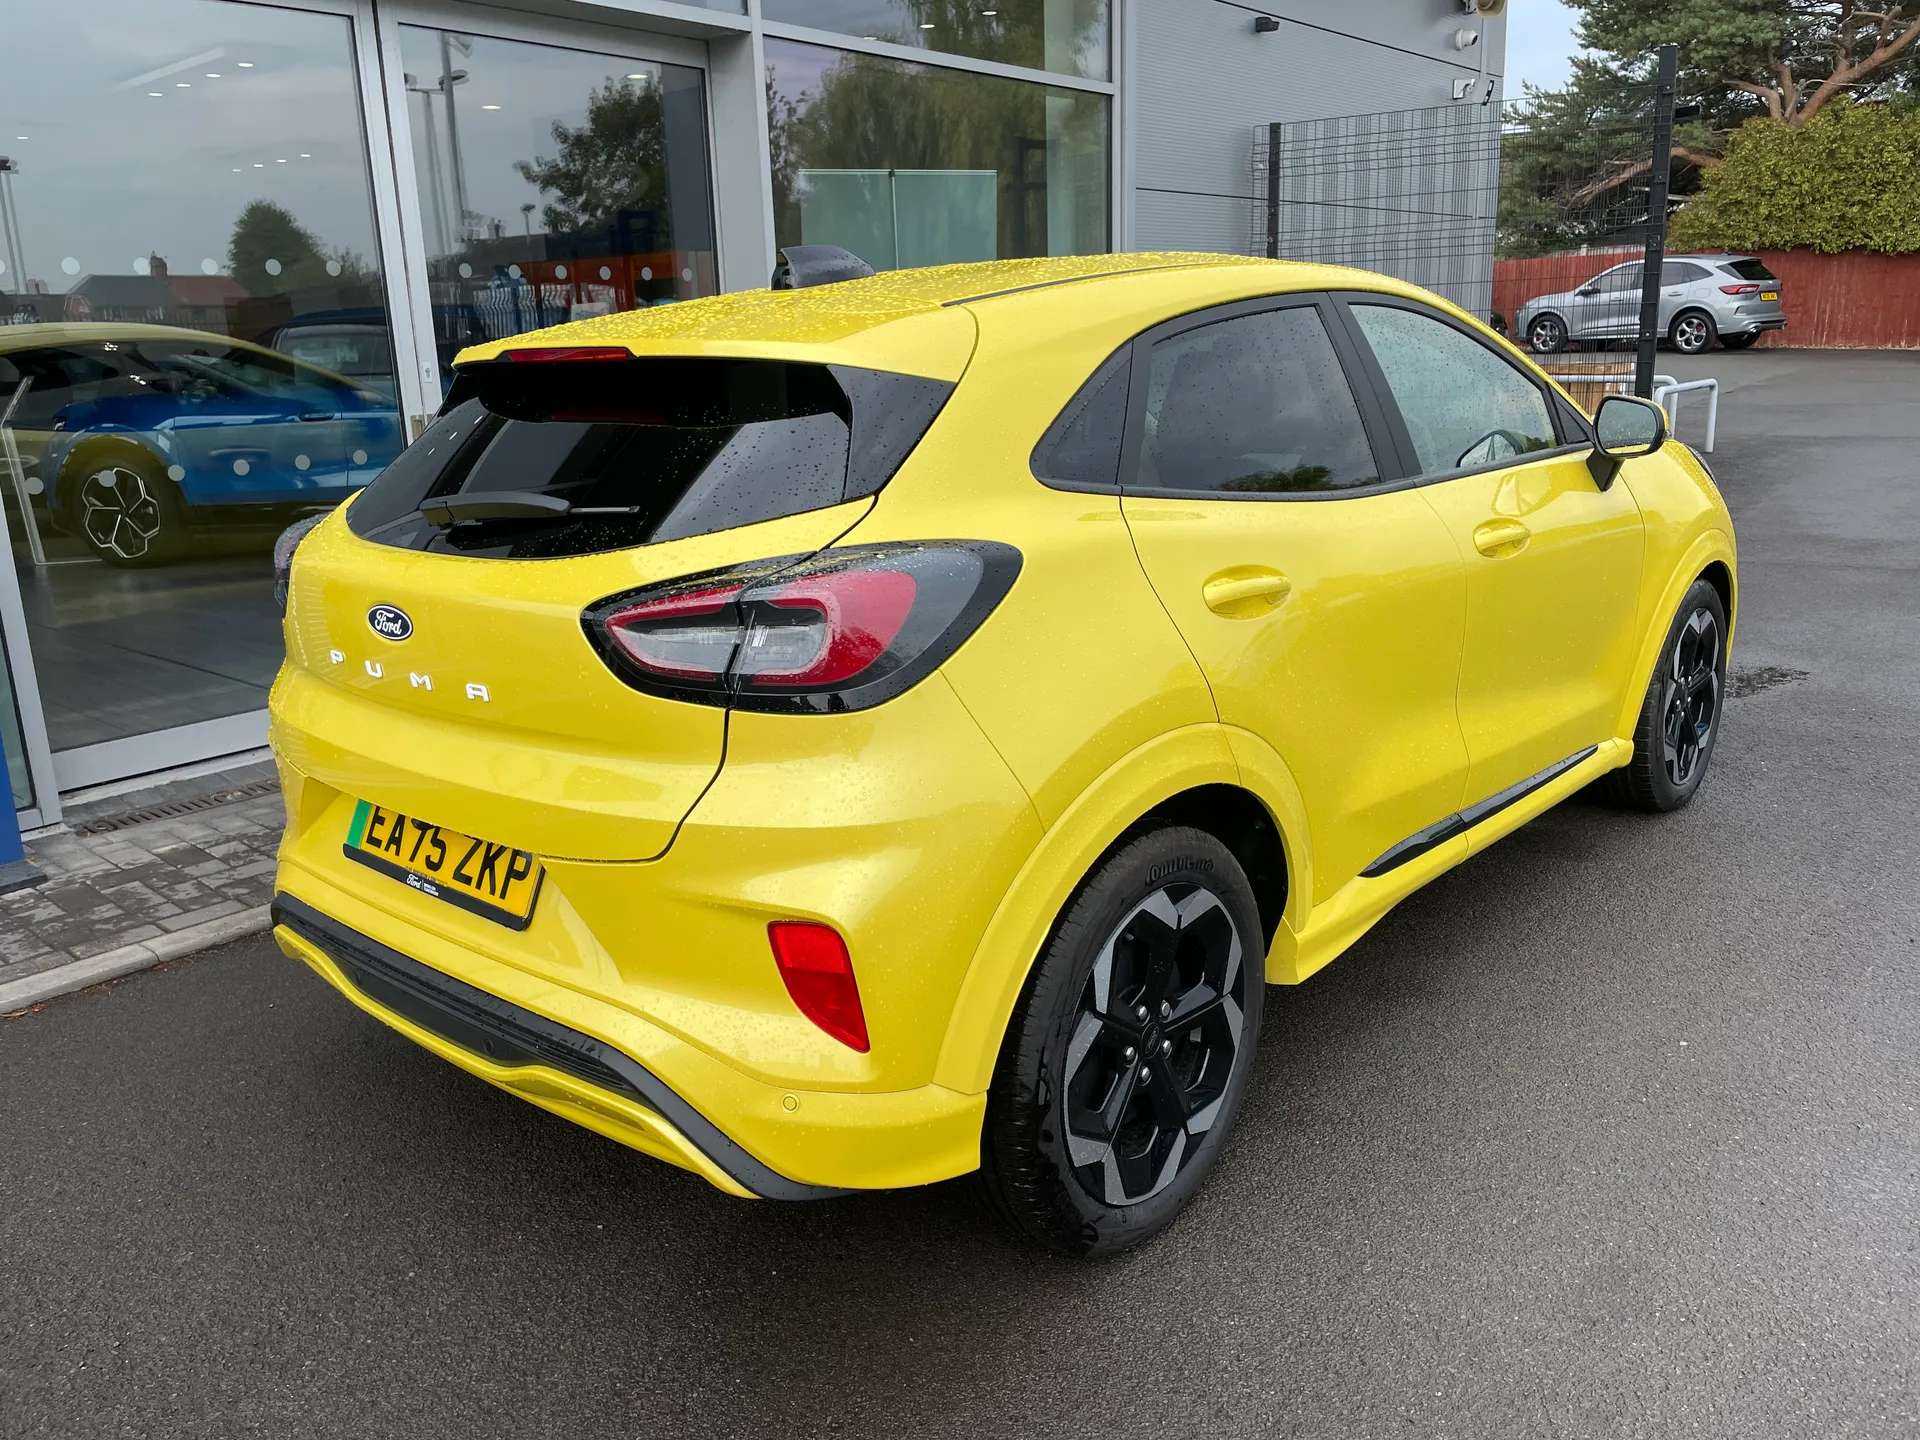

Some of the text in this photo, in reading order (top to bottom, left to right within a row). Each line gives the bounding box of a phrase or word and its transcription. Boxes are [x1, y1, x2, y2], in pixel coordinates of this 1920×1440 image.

[373, 608, 404, 636] Ford
[329, 649, 491, 703] PUMA
[365, 805, 533, 900] EA75 ZKP
